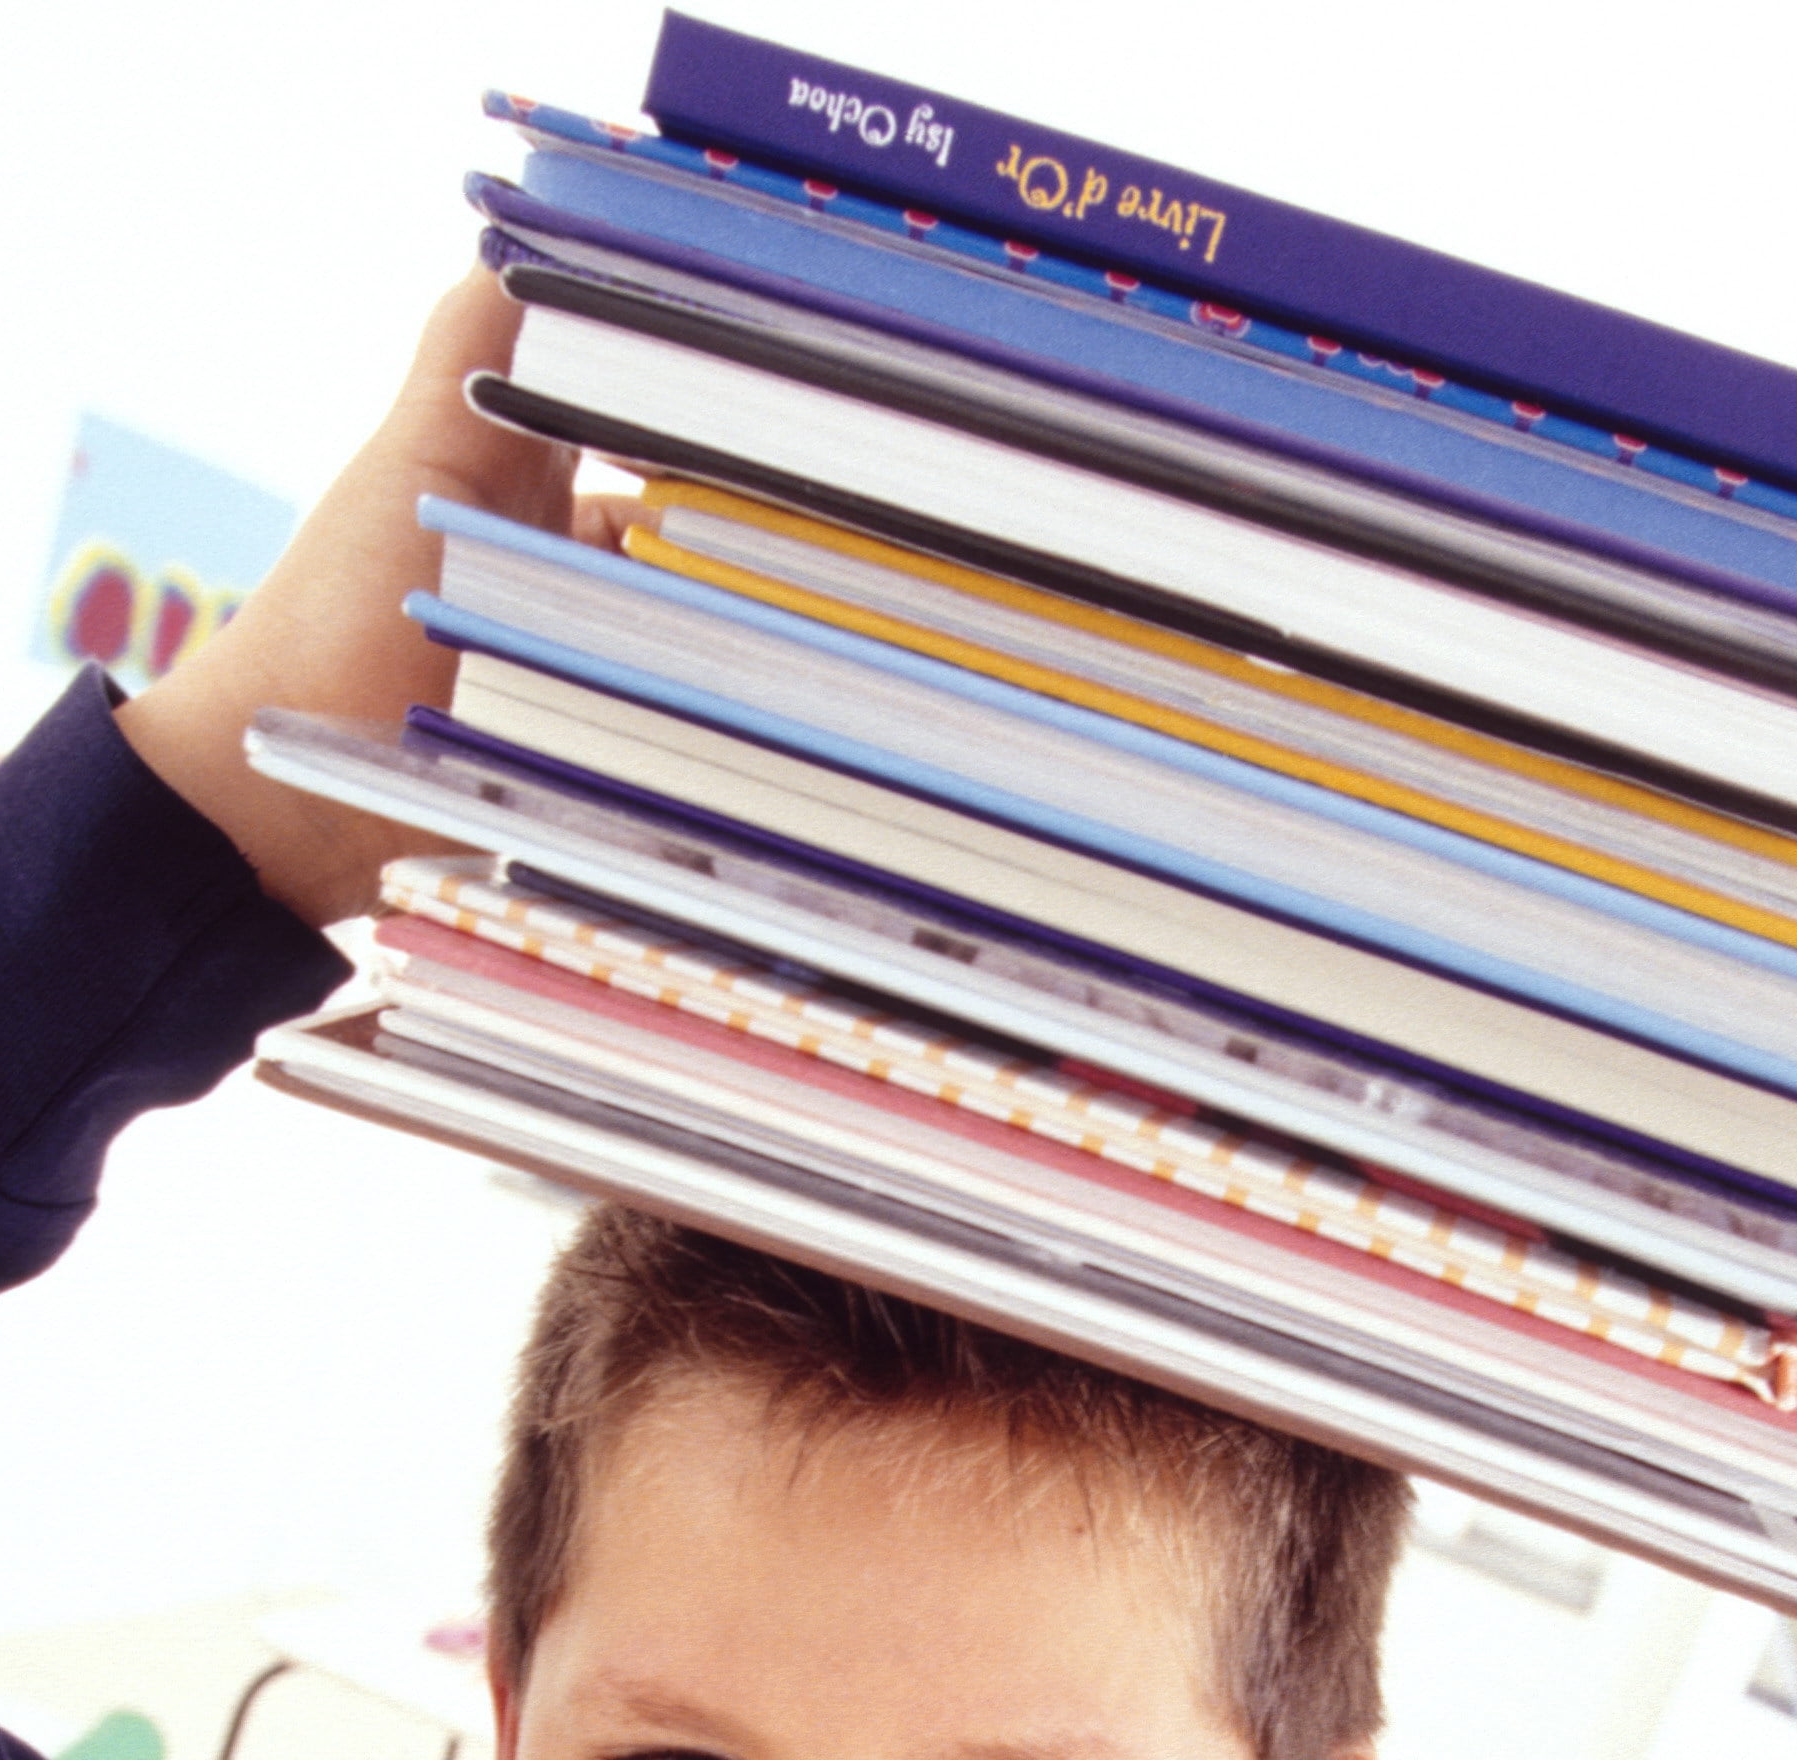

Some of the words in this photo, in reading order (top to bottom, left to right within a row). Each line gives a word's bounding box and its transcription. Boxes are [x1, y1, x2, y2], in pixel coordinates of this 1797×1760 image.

[788, 77, 896, 146] Ochoa
[905, 104, 955, 167] Isy
[996, 144, 1108, 219] d'Or
[1116, 184, 1226, 263] Livre
